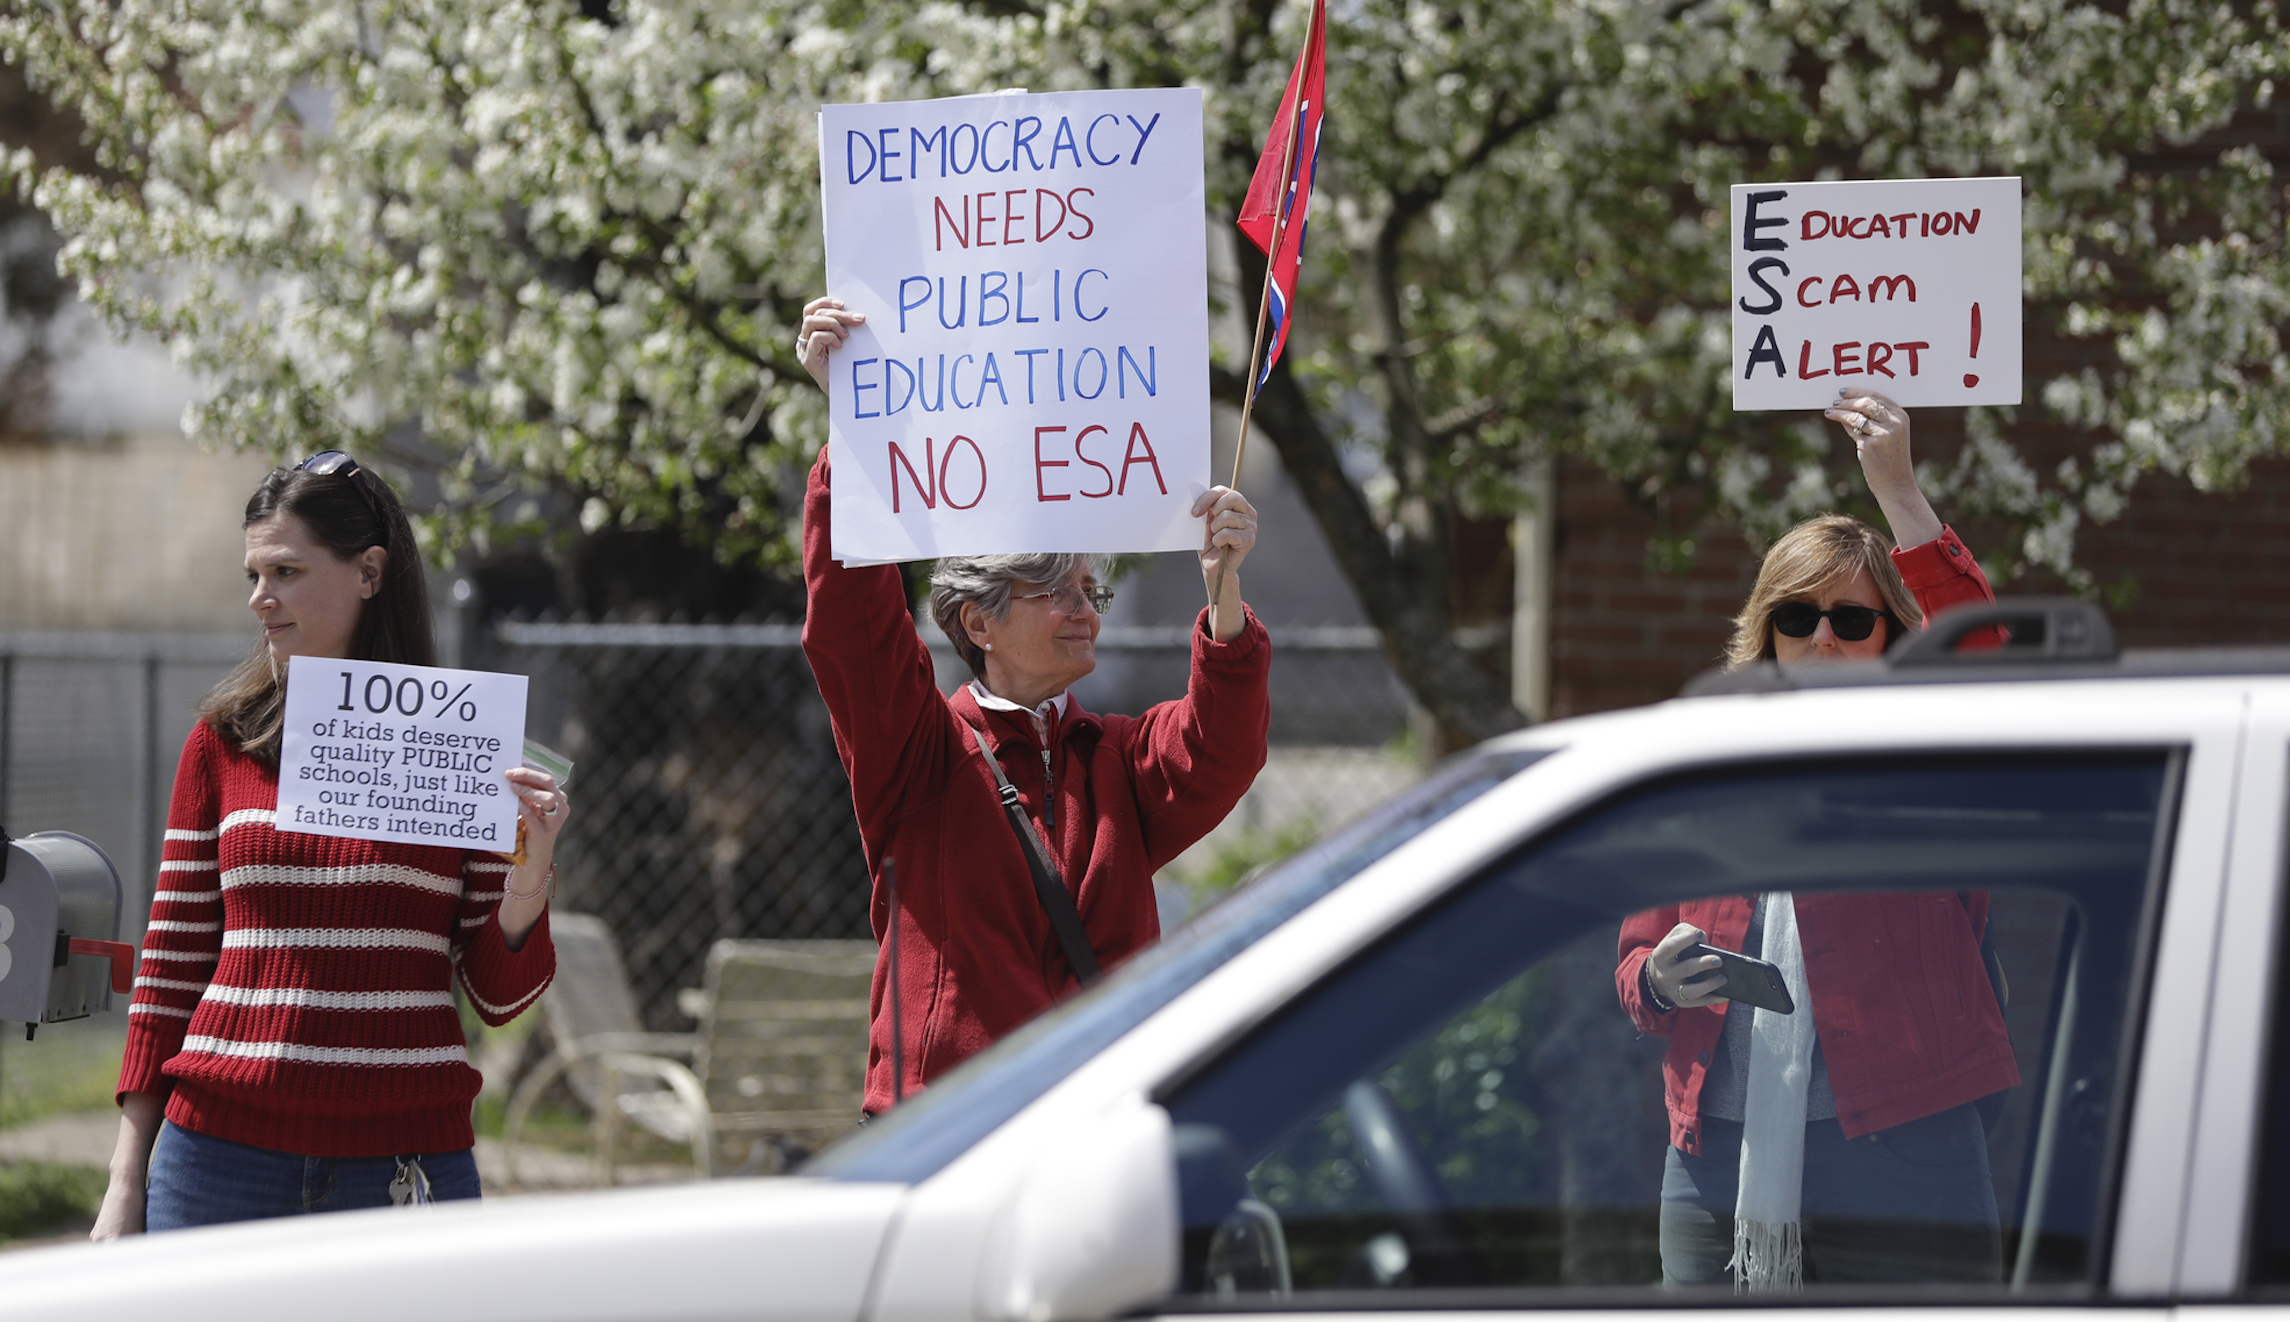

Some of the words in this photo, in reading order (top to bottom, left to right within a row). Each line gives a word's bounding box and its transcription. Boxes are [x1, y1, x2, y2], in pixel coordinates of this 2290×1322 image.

[847, 112, 1160, 184] DEMOCRACY
[934, 187, 1095, 251] NEEDS
[899, 269, 1109, 333] PUBLIC
[852, 346, 1156, 419] EDUCATION
[888, 435, 987, 513] NO
[1035, 422, 1168, 502] ESA
[336, 671, 478, 722] 100%
[309, 743, 395, 769] quality
[402, 747, 492, 773] PUBLIC
[312, 719, 338, 737] of
[341, 720, 394, 742] kids
[402, 726, 500, 751] deserve
[299, 765, 398, 790] schools,
[403, 770, 448, 792] just
[454, 775, 499, 796] like
[319, 791, 361, 804] our
[367, 790, 477, 821] founding
[294, 805, 379, 831] fathers
[387, 815, 497, 841] intended
